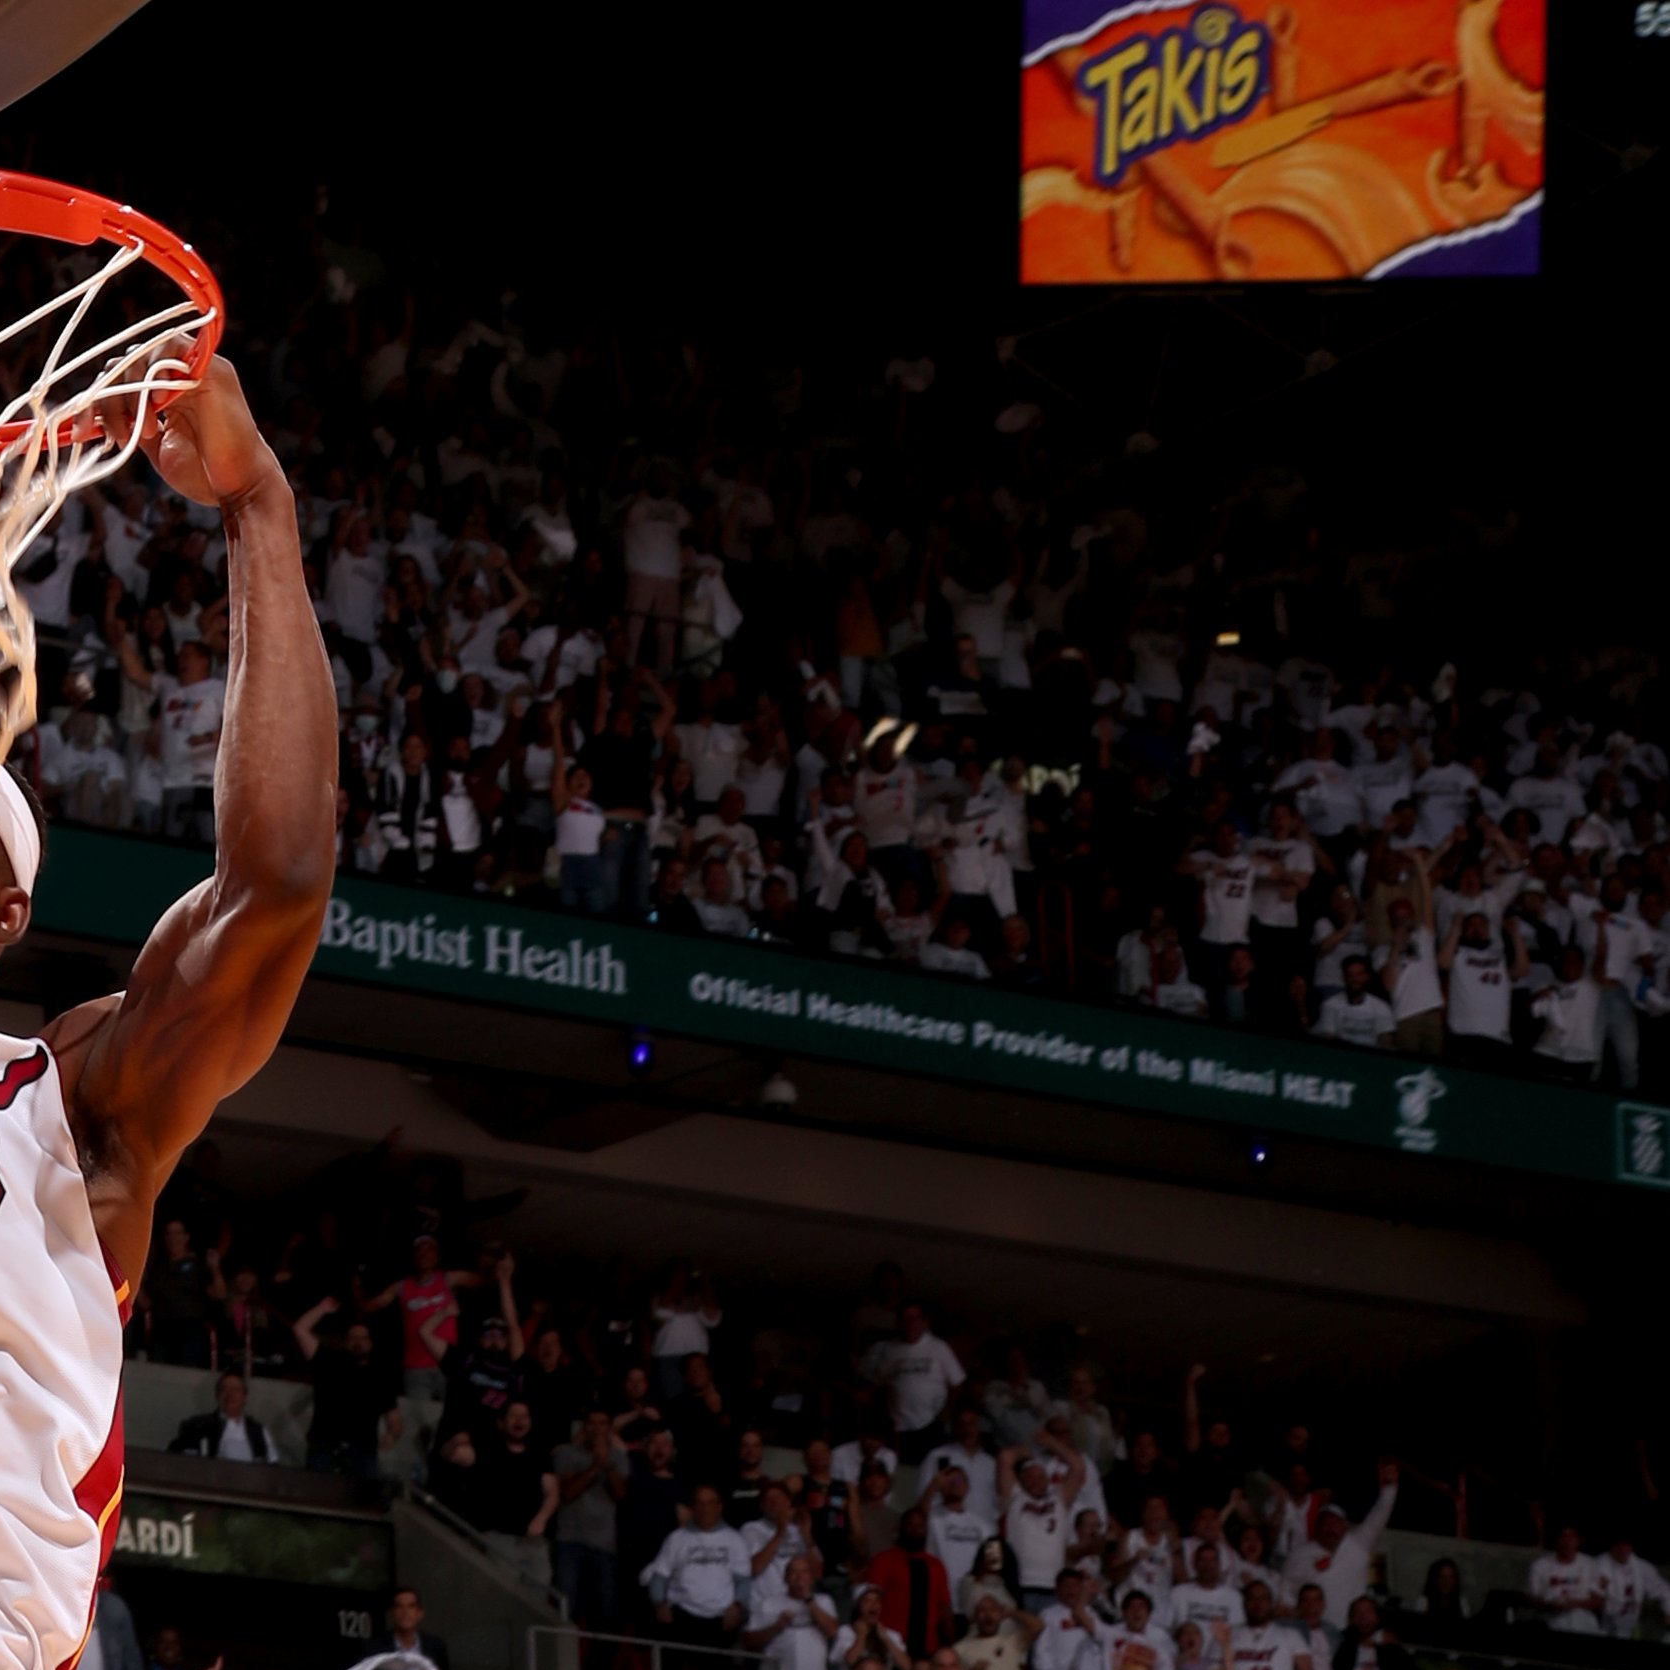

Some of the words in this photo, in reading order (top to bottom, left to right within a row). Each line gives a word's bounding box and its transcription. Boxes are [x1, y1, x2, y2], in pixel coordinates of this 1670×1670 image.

[1085, 9, 1262, 175] Takis
[322, 898, 472, 968] Baptist
[485, 925, 628, 995] Health
[689, 972, 801, 1017] Official
[807, 993, 966, 1046] Healthcare
[973, 1021, 1094, 1067] Provider
[1100, 1045, 1132, 1072] of
[1136, 1050, 1184, 1083] the
[1189, 1058, 1276, 1098] Miami
[1282, 1073, 1356, 1110] HEAT
[115, 1513, 195, 1558] ARDÍ
[338, 1610, 371, 1639] 120
